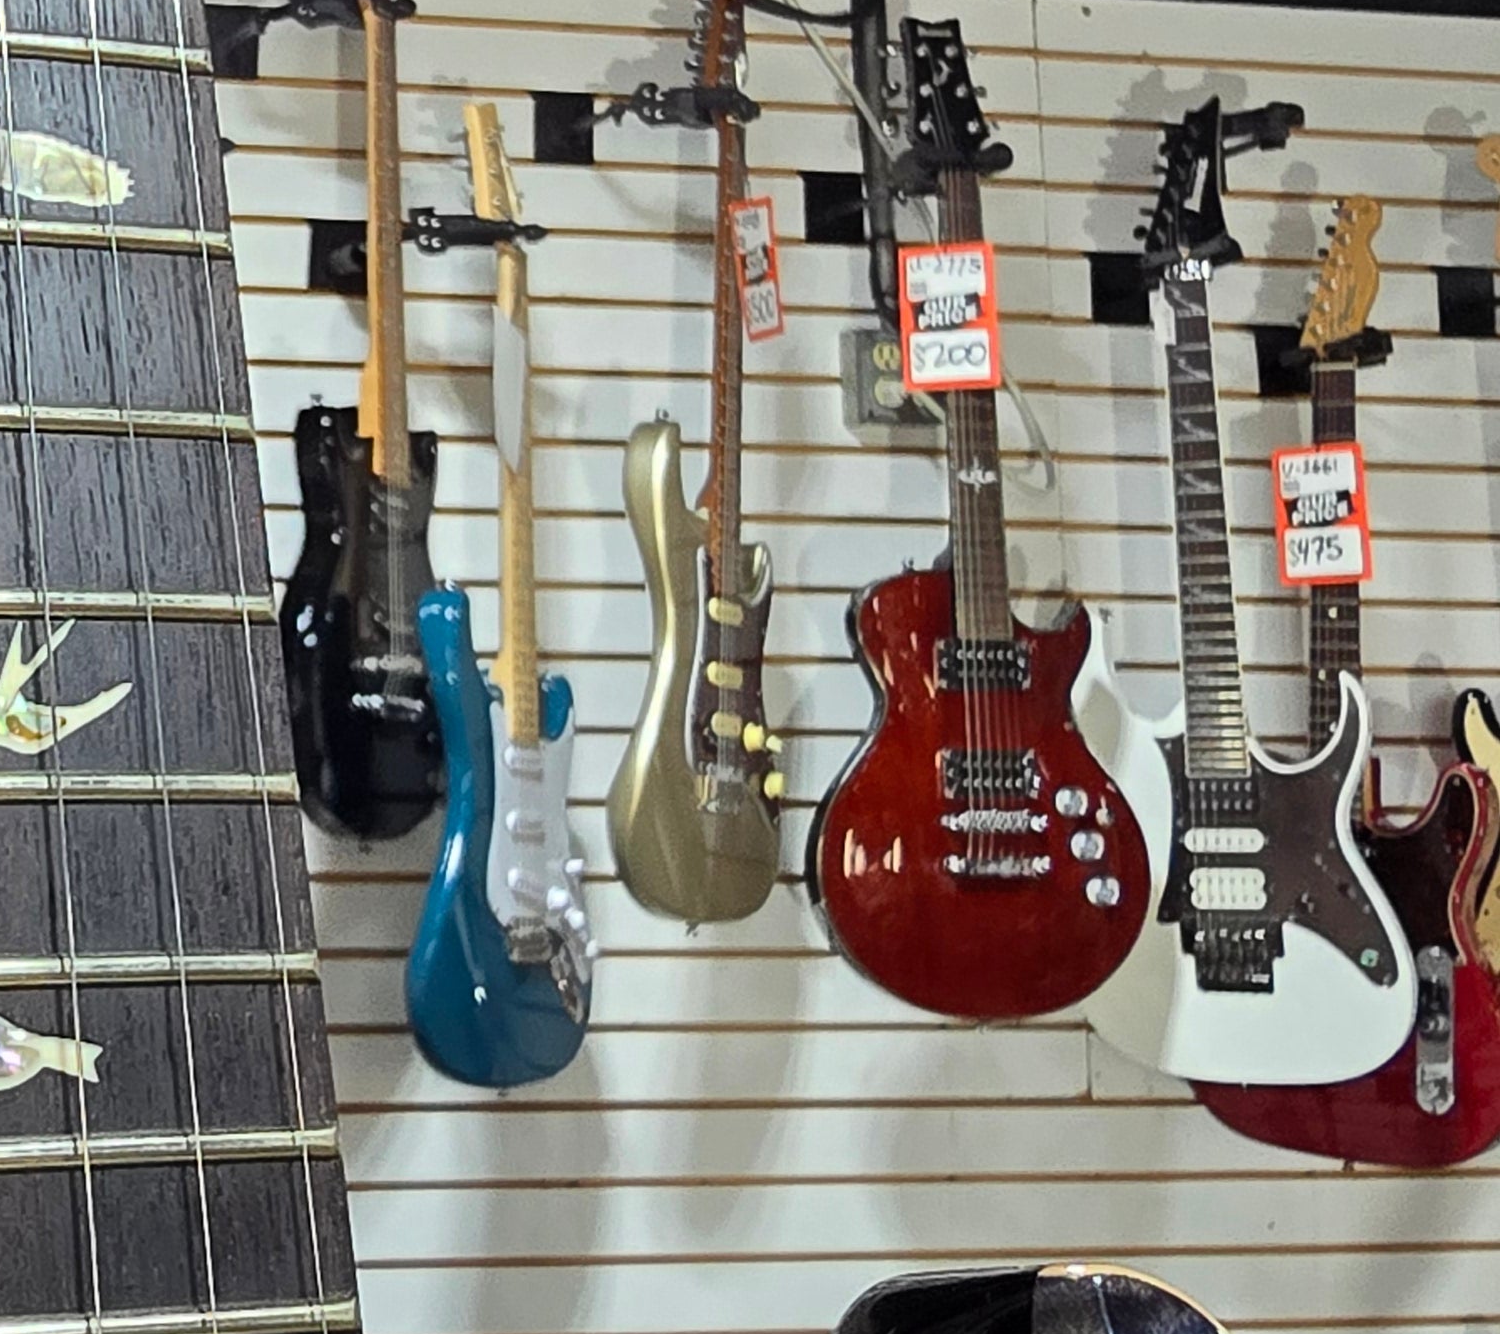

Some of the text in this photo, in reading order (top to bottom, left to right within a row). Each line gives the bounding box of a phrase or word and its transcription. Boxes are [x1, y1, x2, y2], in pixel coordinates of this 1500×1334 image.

[918, 306, 978, 330] PRICE
[924, 296, 966, 315] OUR
[915, 341, 987, 373] $200
[1292, 501, 1349, 527] PRICE
[1297, 492, 1338, 512] OUR
[1287, 534, 1343, 568] $475
